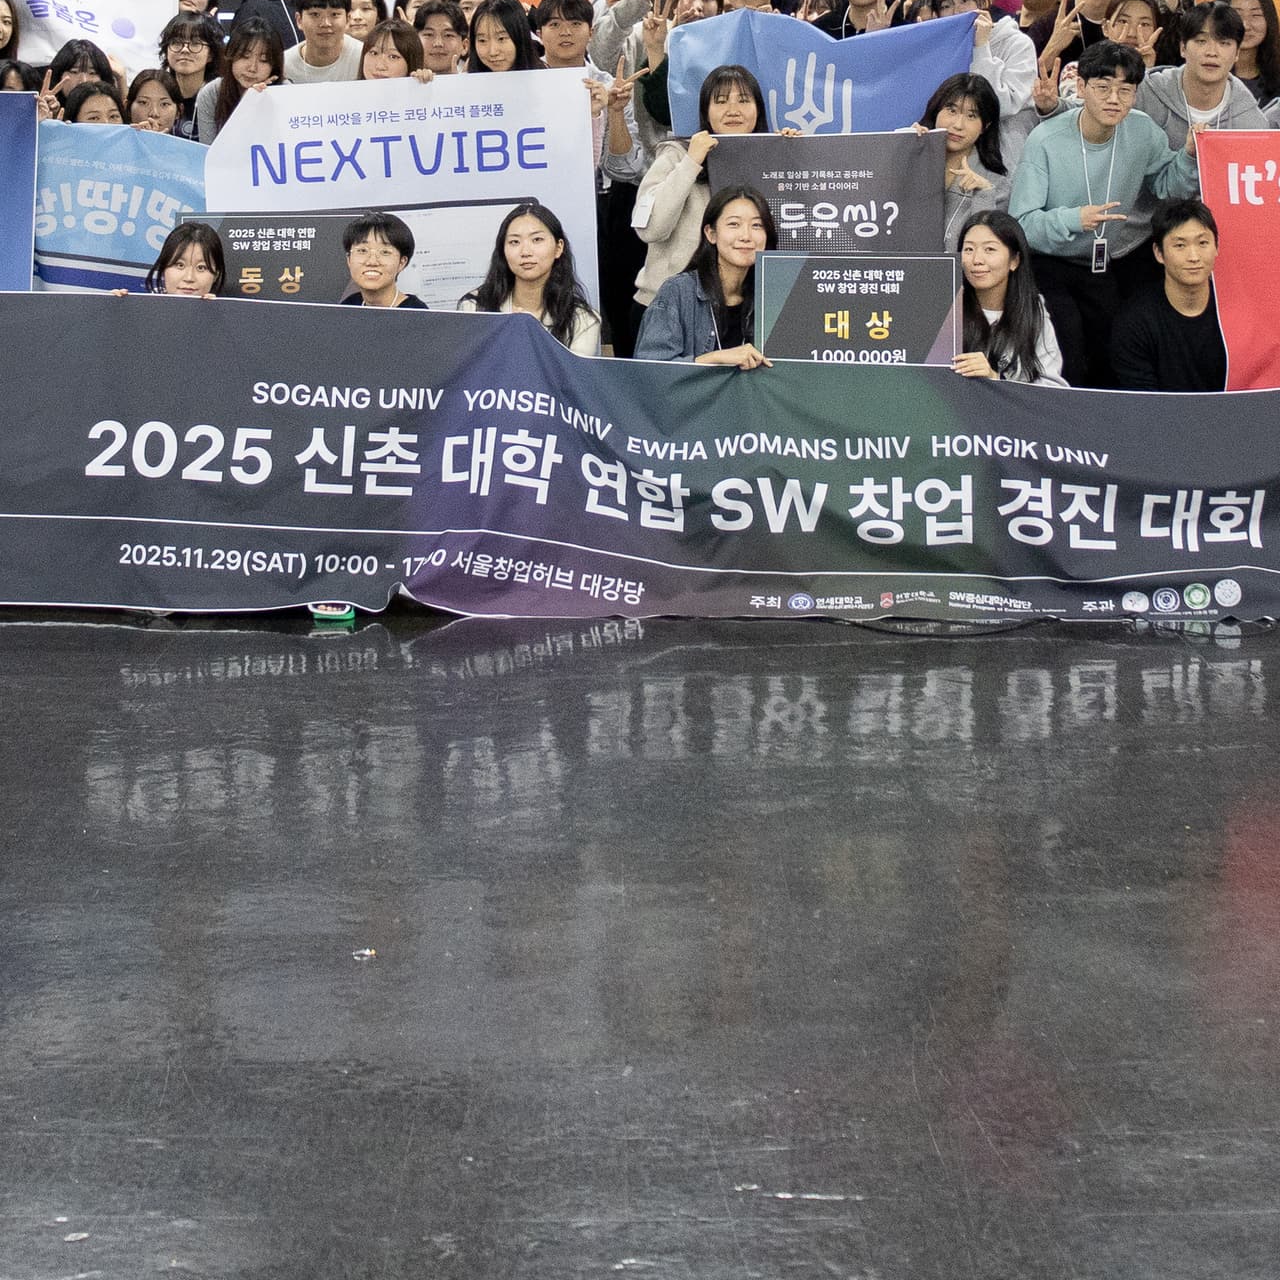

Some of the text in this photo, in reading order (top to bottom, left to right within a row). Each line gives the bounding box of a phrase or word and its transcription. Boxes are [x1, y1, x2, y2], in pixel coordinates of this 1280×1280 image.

[288, 103, 505, 131] 생각의 씨앗을 키우는 코딩 사고력 플랫폼
[249, 126, 548, 187] NEXTVIBE
[761, 169, 874, 180] 노래로 일상을 기록하고 공유하는
[777, 181, 859, 191] 음악 기반 다이어리
[228, 227, 316, 239] 2025 신촌 대학 연합
[232, 240, 311, 251] SW 창업 경진 대회
[238, 265, 305, 295] 동 상
[812, 269, 905, 282] 2025 신촌 대학 연합
[817, 282, 900, 294] SW 창업 경진 대회
[824, 310, 893, 340] 대 상
[252, 381, 1109, 469] SOGANG UNIV YONSEI UNIV EWHA WOMANS UNIV HONGIK UNIV
[85, 419, 1266, 552] 2025 신촌 대학 연합 SW 창업 경진 대회
[119, 542, 645, 606] 2025.11.29(SAT) 10:00 서울창업허브 대강당
[750, 595, 782, 610] 주최
[815, 596, 863, 607] 연세대학교
[1082, 599, 1116, 613] 주관
